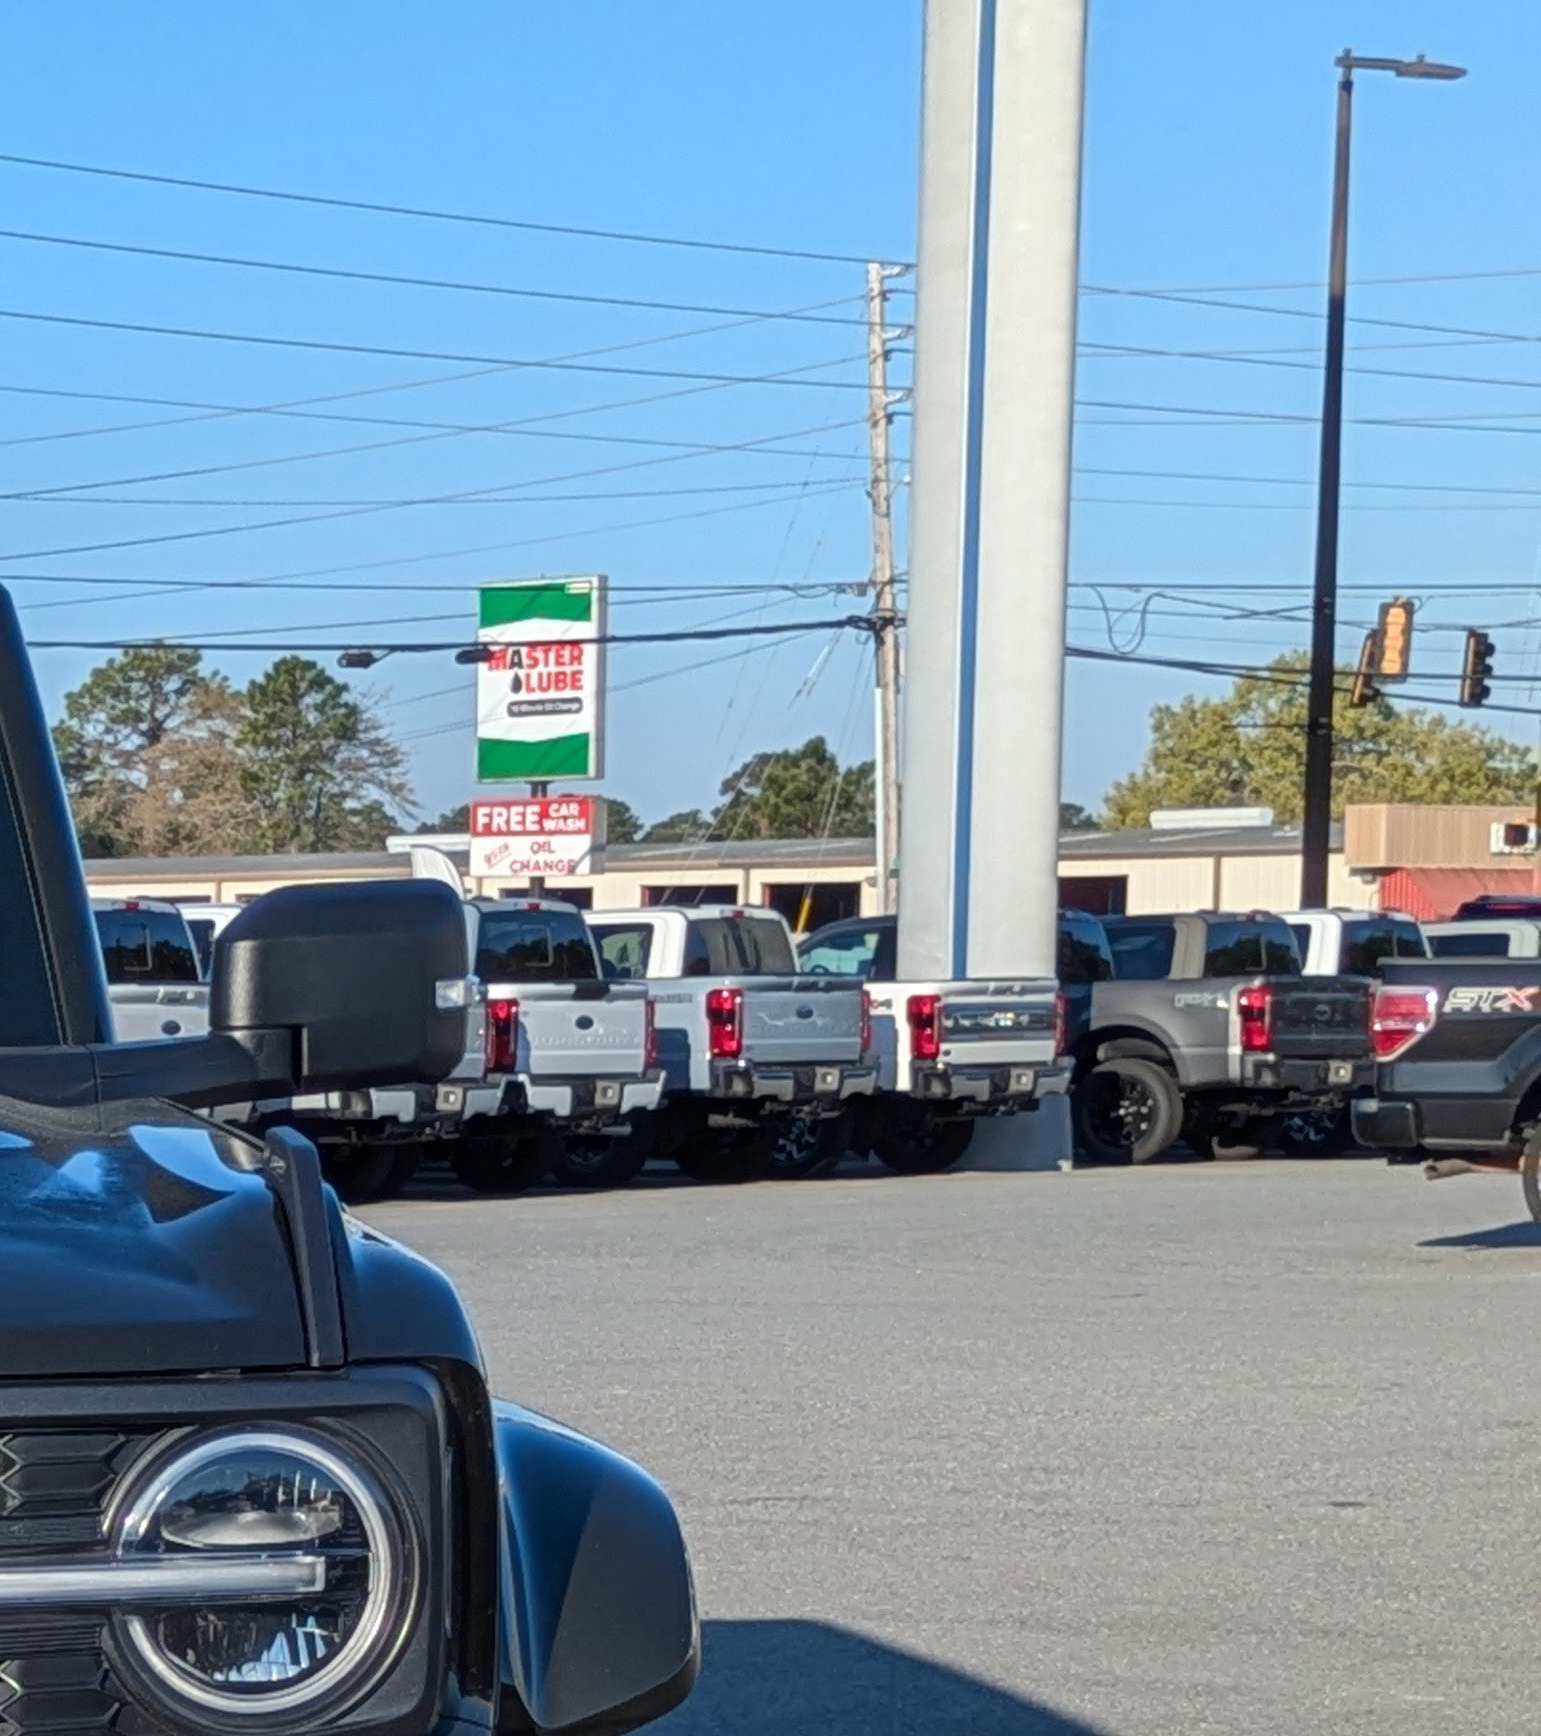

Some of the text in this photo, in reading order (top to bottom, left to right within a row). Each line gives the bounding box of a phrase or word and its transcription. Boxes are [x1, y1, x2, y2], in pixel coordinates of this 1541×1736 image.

[487, 641, 583, 671] MASTER
[524, 670, 583, 693] LUBE
[477, 804, 541, 832] FREE
[548, 802, 580, 817] CAR
[542, 818, 586, 831] WASH
[530, 841, 555, 854] OIL
[509, 859, 577, 873] CHANGE
[1442, 986, 1539, 1013] STX
